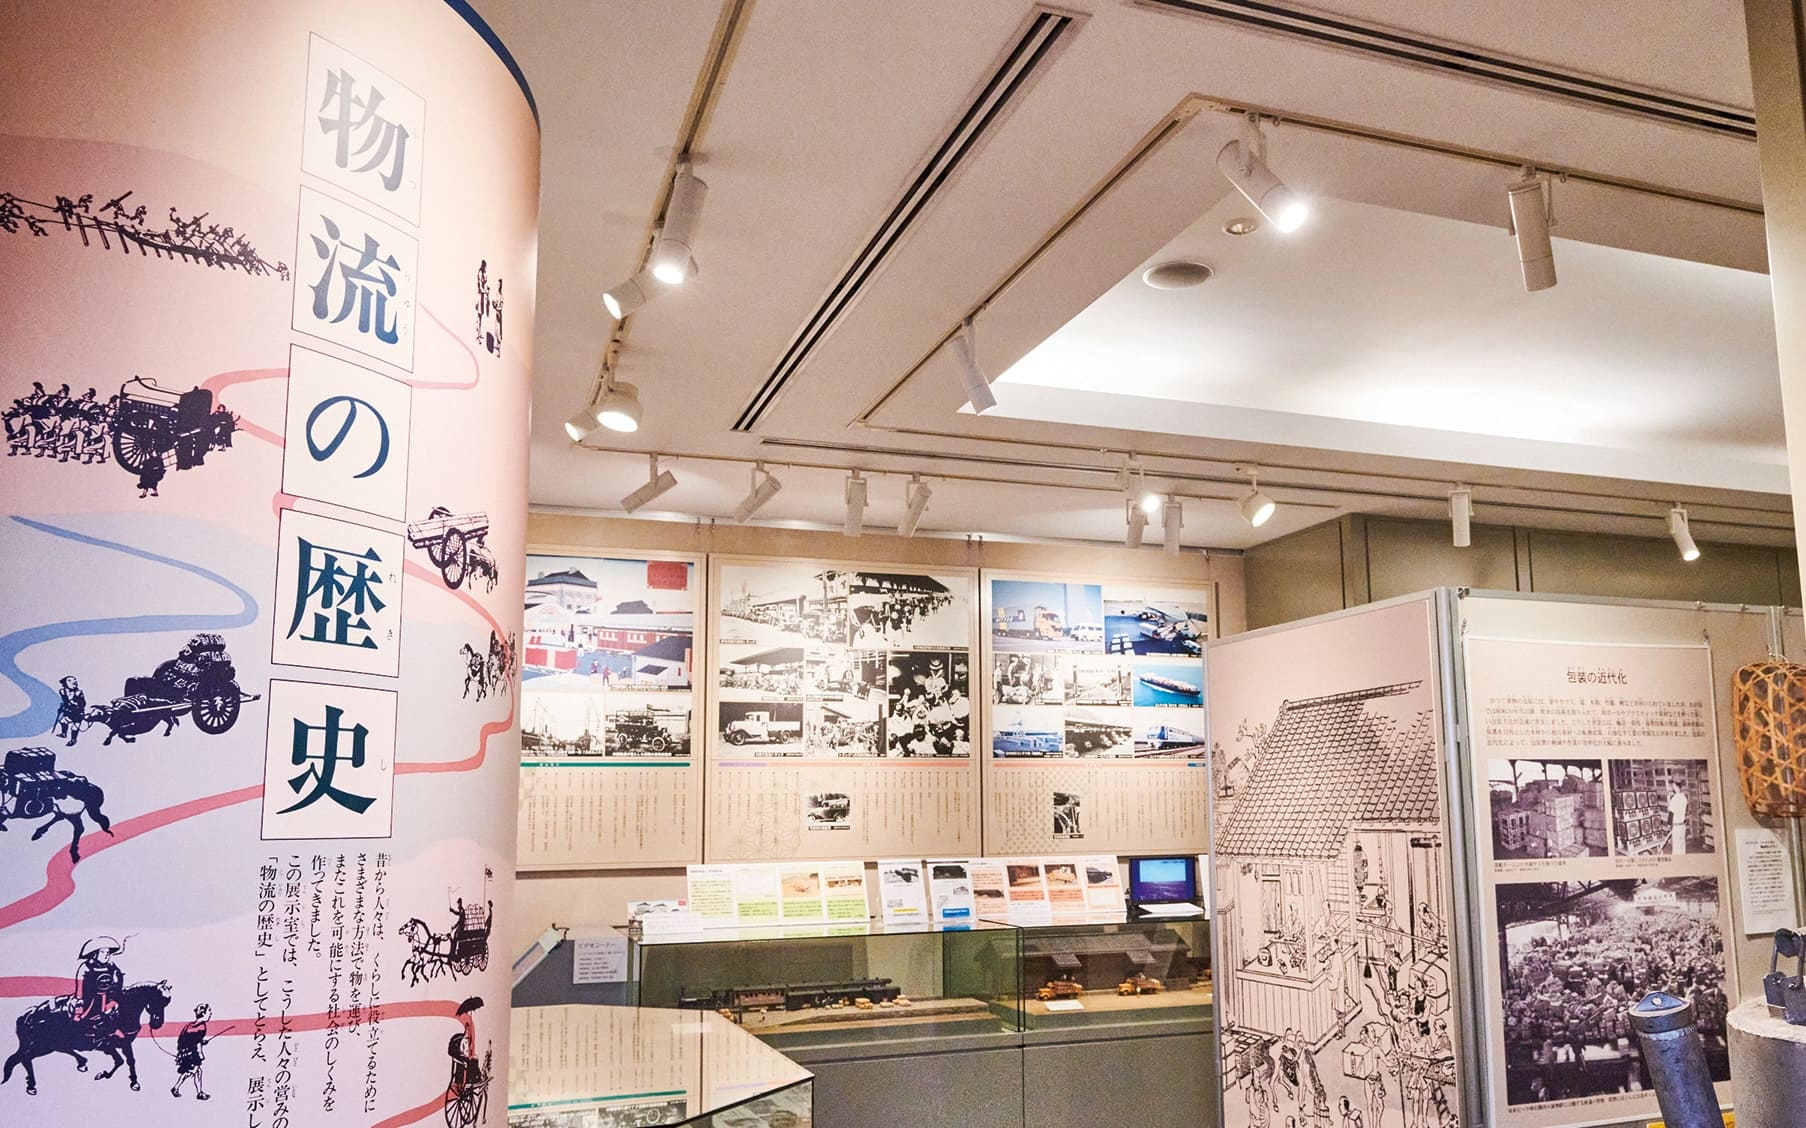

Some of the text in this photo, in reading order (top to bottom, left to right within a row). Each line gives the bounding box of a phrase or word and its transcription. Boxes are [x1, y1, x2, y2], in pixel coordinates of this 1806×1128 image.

[276, 67, 409, 814] 物流の歴史
[1567, 671, 1627, 685] 包装の近代化
[307, 855, 327, 959] 作ってきました。
[323, 854, 346, 1112] またこれを可能にする社会のしくみを
[347, 854, 367, 1036] さまざまな方法で物を運び、
